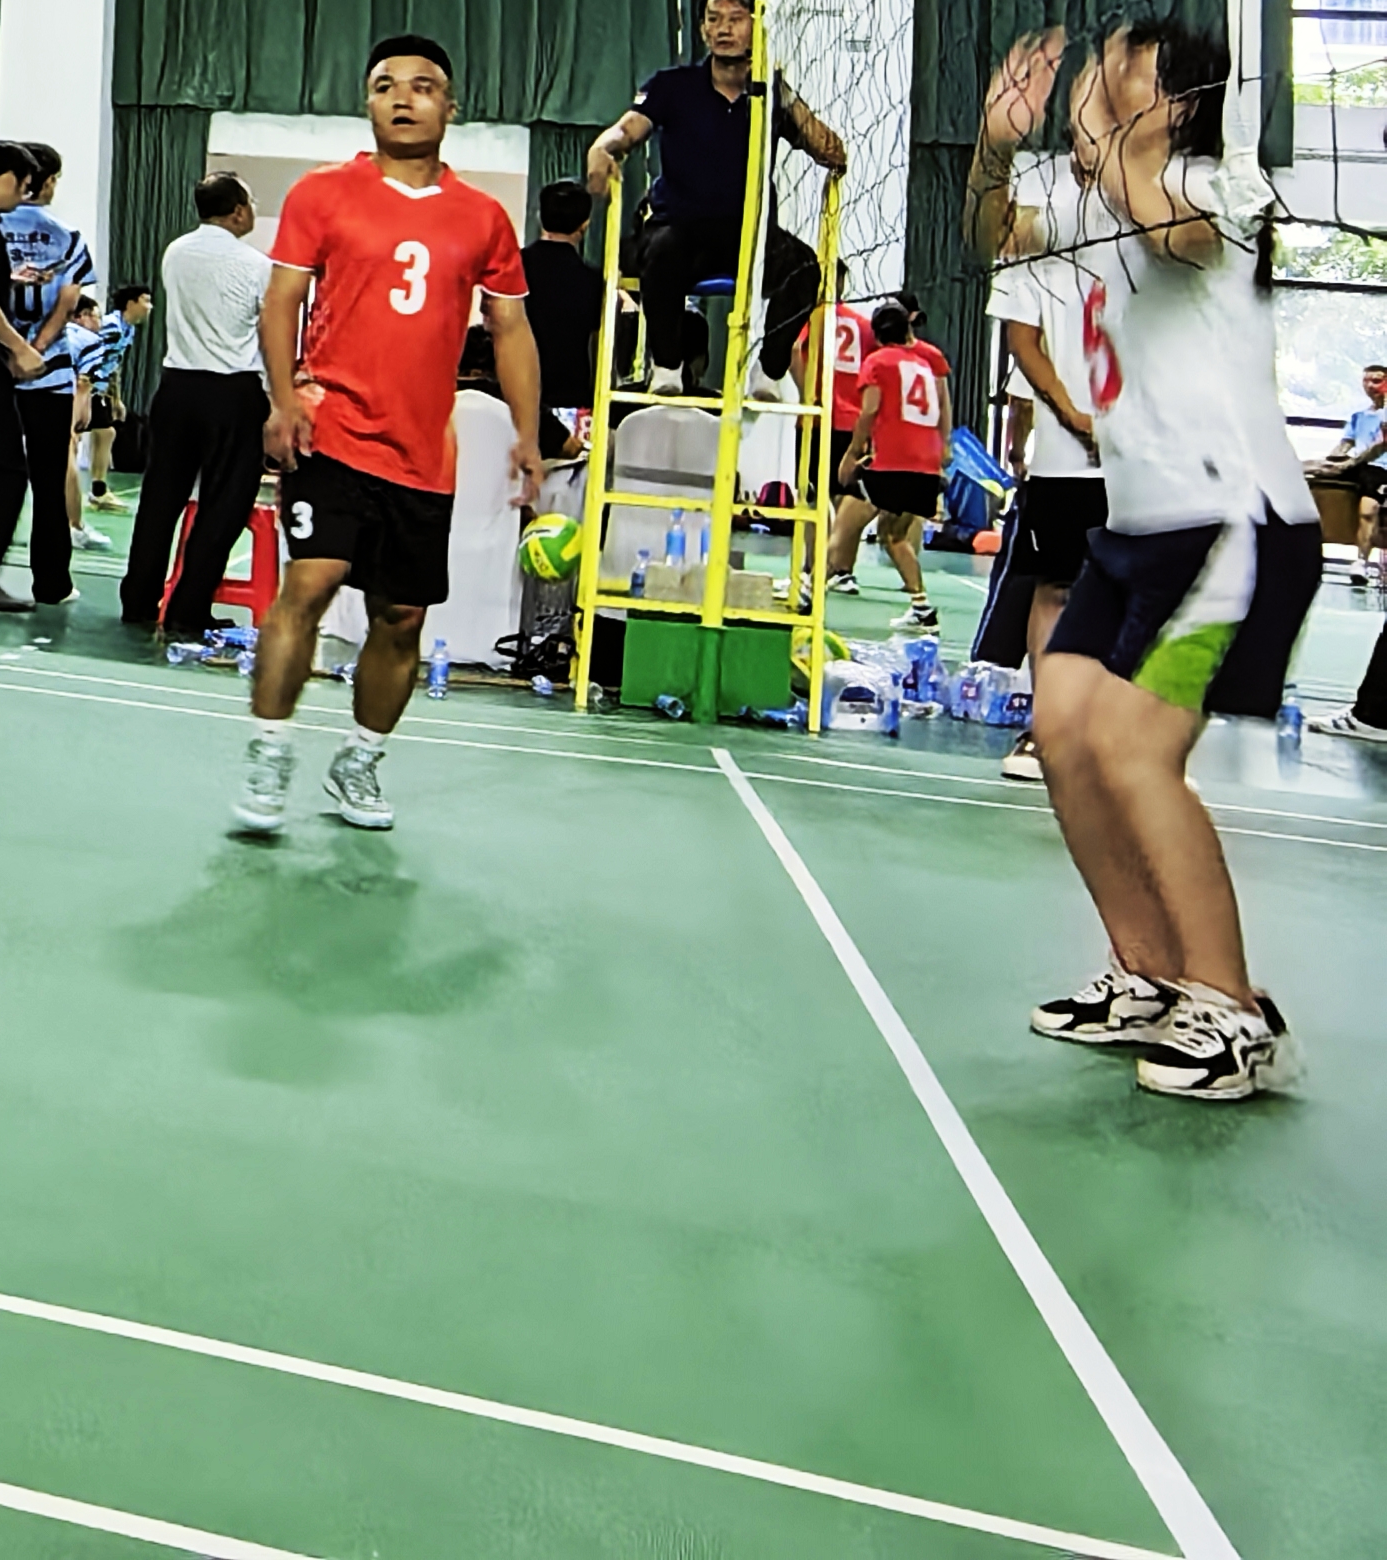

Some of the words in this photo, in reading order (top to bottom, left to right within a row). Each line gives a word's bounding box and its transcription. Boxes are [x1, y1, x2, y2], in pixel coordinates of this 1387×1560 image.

[389, 240, 430, 315] 3
[906, 373, 930, 416] 4
[290, 501, 314, 539] 3
